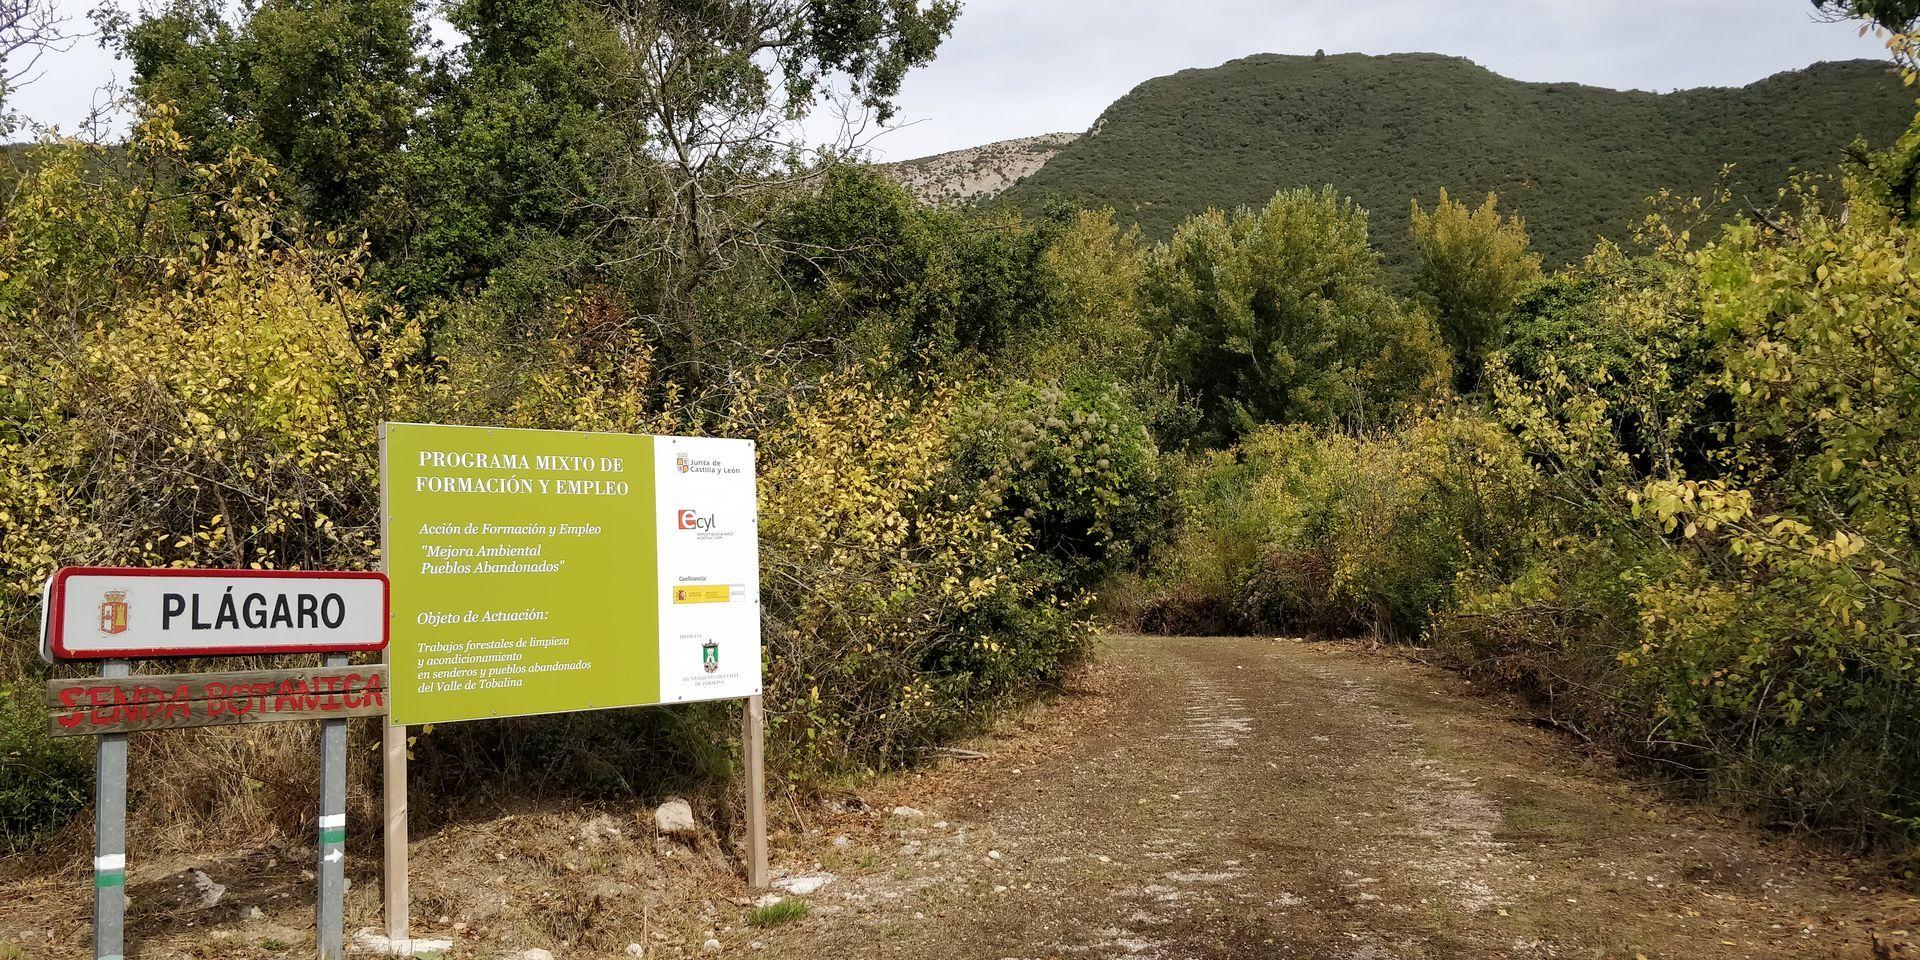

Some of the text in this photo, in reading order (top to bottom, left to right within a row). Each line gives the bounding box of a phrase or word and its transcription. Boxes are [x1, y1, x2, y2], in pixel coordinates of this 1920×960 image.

[418, 451, 624, 473] PROGRAMA MIXTO DE
[415, 474, 629, 496] FORMACIÓN Y EMPLEO
[419, 523, 602, 537] Acción de Formación y Empleo
[421, 544, 542, 560] "Mejora Ambiental
[421, 560, 566, 575] Pueblos Abandonados"
[162, 586, 346, 630] PLÁGARO
[417, 608, 549, 627] Objeto de Actuación:
[418, 636, 570, 653] Trabajos forestales de limpieza
[418, 652, 523, 668] y acondicionamiento
[418, 659, 592, 679] en senderos y pueblos abandonados
[418, 677, 523, 693] del Valle de Tobalina
[58, 673, 384, 728] SENDA BOTANICA
